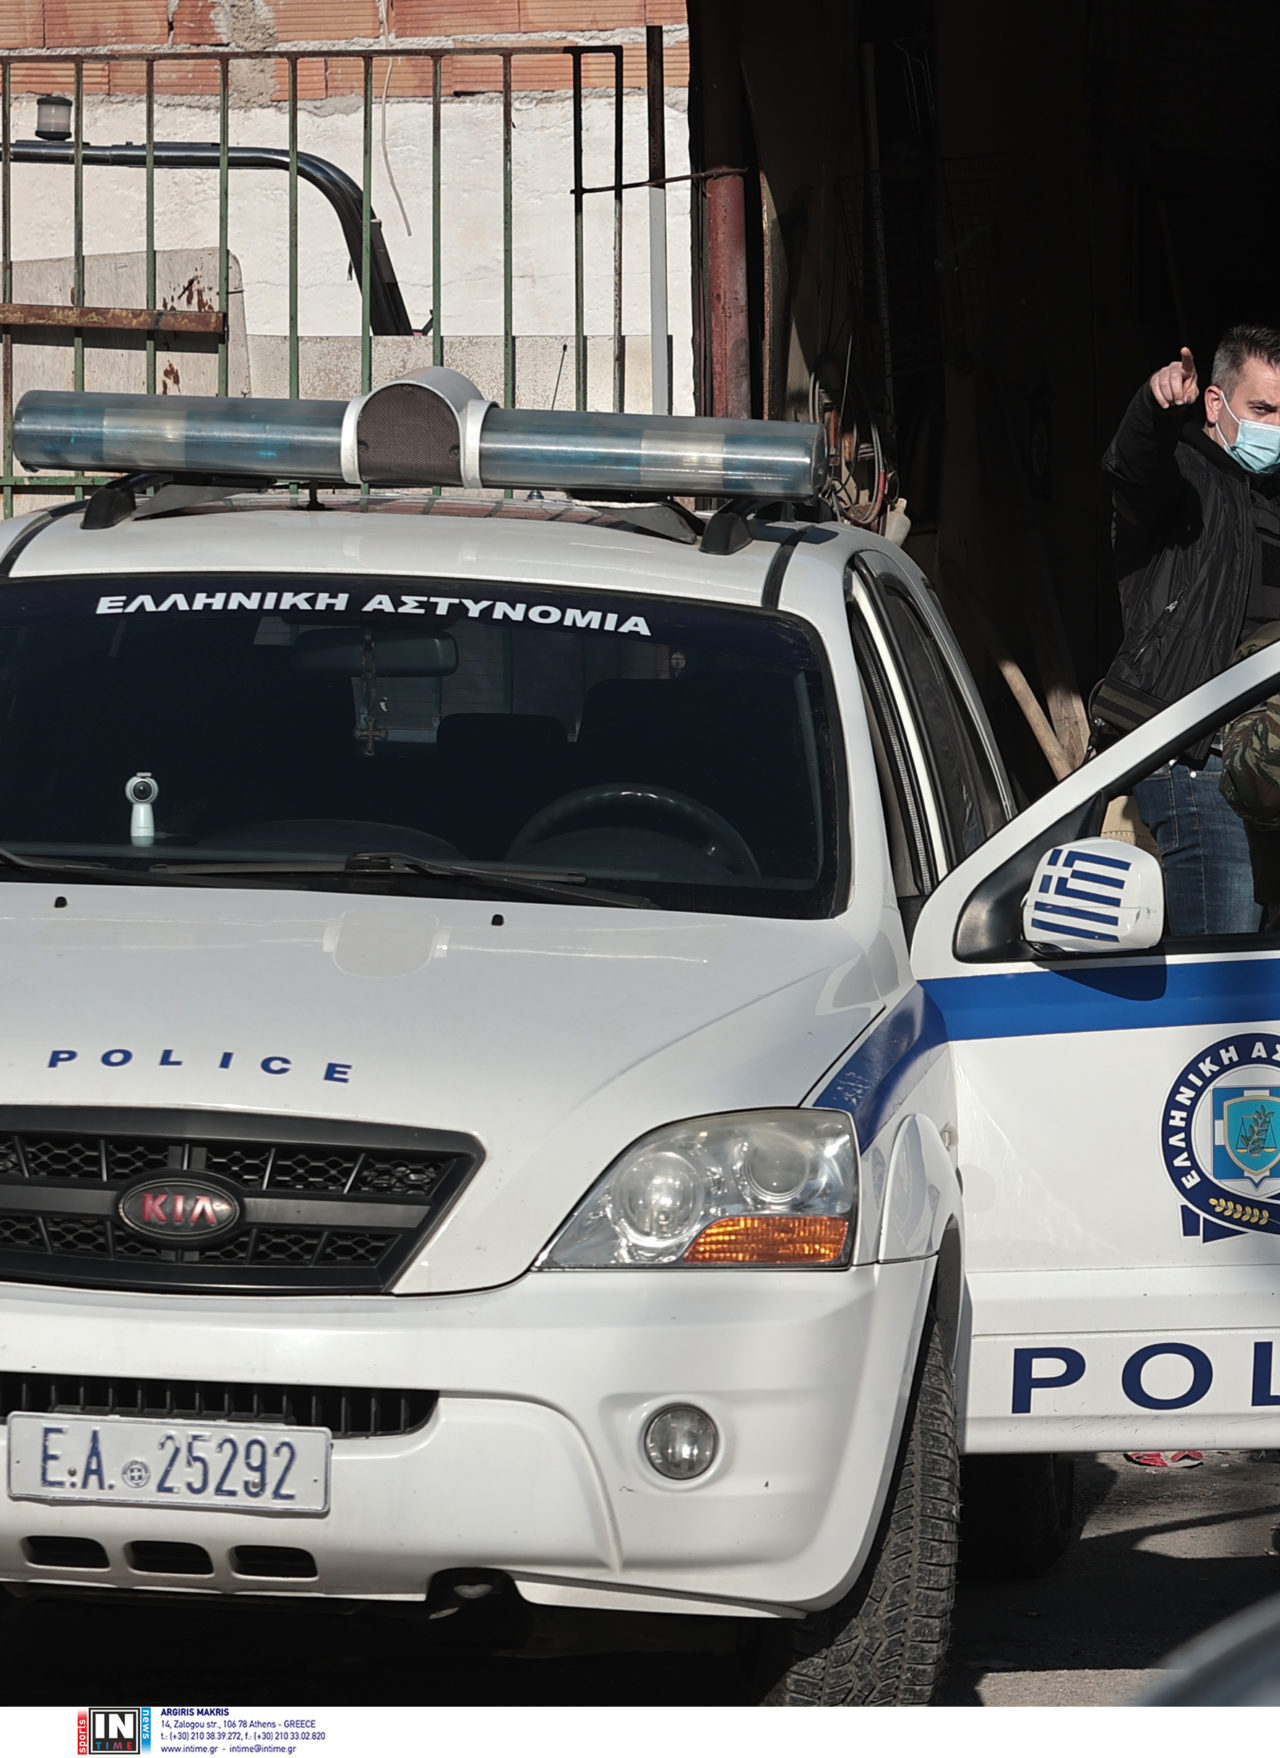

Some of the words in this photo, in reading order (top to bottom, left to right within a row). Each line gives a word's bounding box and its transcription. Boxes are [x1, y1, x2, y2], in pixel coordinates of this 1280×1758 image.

[96, 592, 350, 614] ΕΛΛΗΝΙΚΗ
[361, 594, 652, 636] ΑΣΤΥΝΟΜΙΑ
[48, 1049, 352, 1083] POLICE
[1168, 1045, 1240, 1190] ΕΛΛΗΝΙΚΗ
[142, 1192, 217, 1224] KIA
[157, 1433, 296, 1500] 25292
